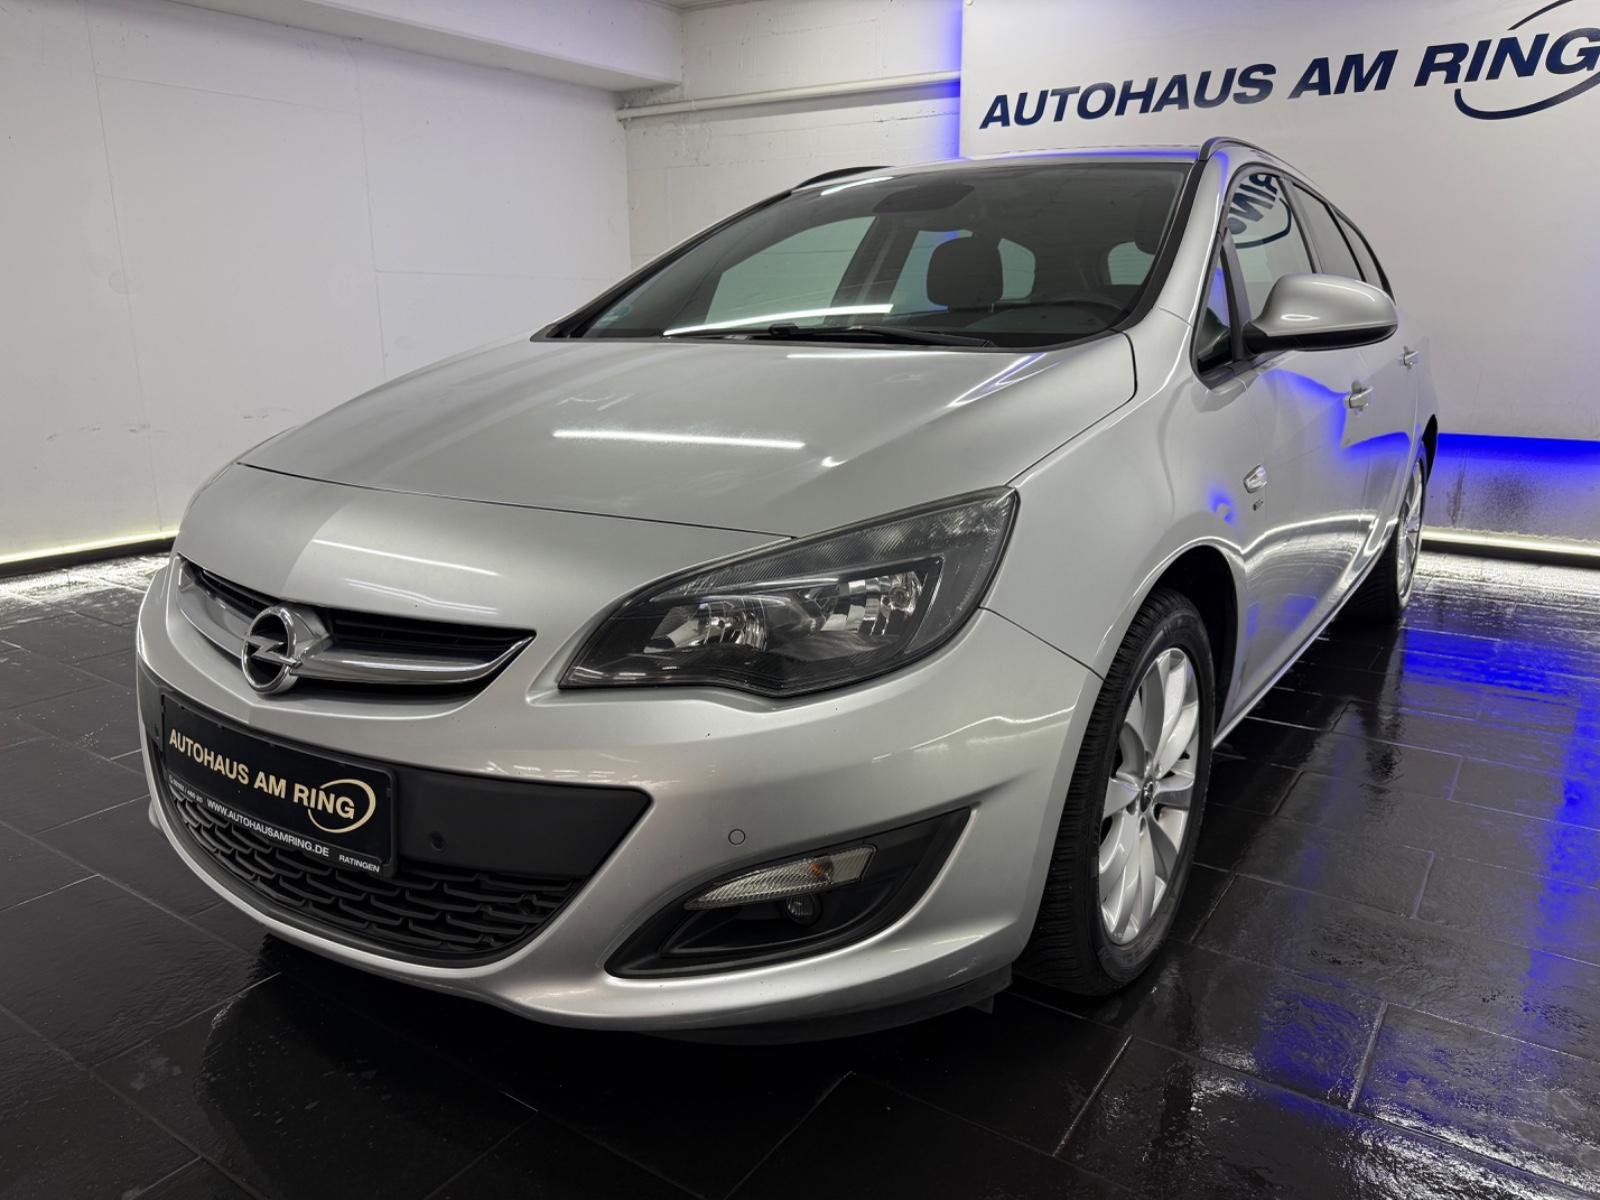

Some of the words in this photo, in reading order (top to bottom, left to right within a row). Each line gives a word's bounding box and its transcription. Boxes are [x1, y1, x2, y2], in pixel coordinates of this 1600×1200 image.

[979, 63, 1276, 129] AUTOHAUS
[1288, 49, 1399, 100] AM
[1413, 27, 1600, 87] RING
[169, 728, 249, 785] AUTOHAUS
[254, 771, 286, 799] AM
[293, 783, 355, 820] RING
[206, 799, 329, 857] WWW.AUTOHAUSAMRING.DE
[339, 854, 380, 873] RATINGEN
